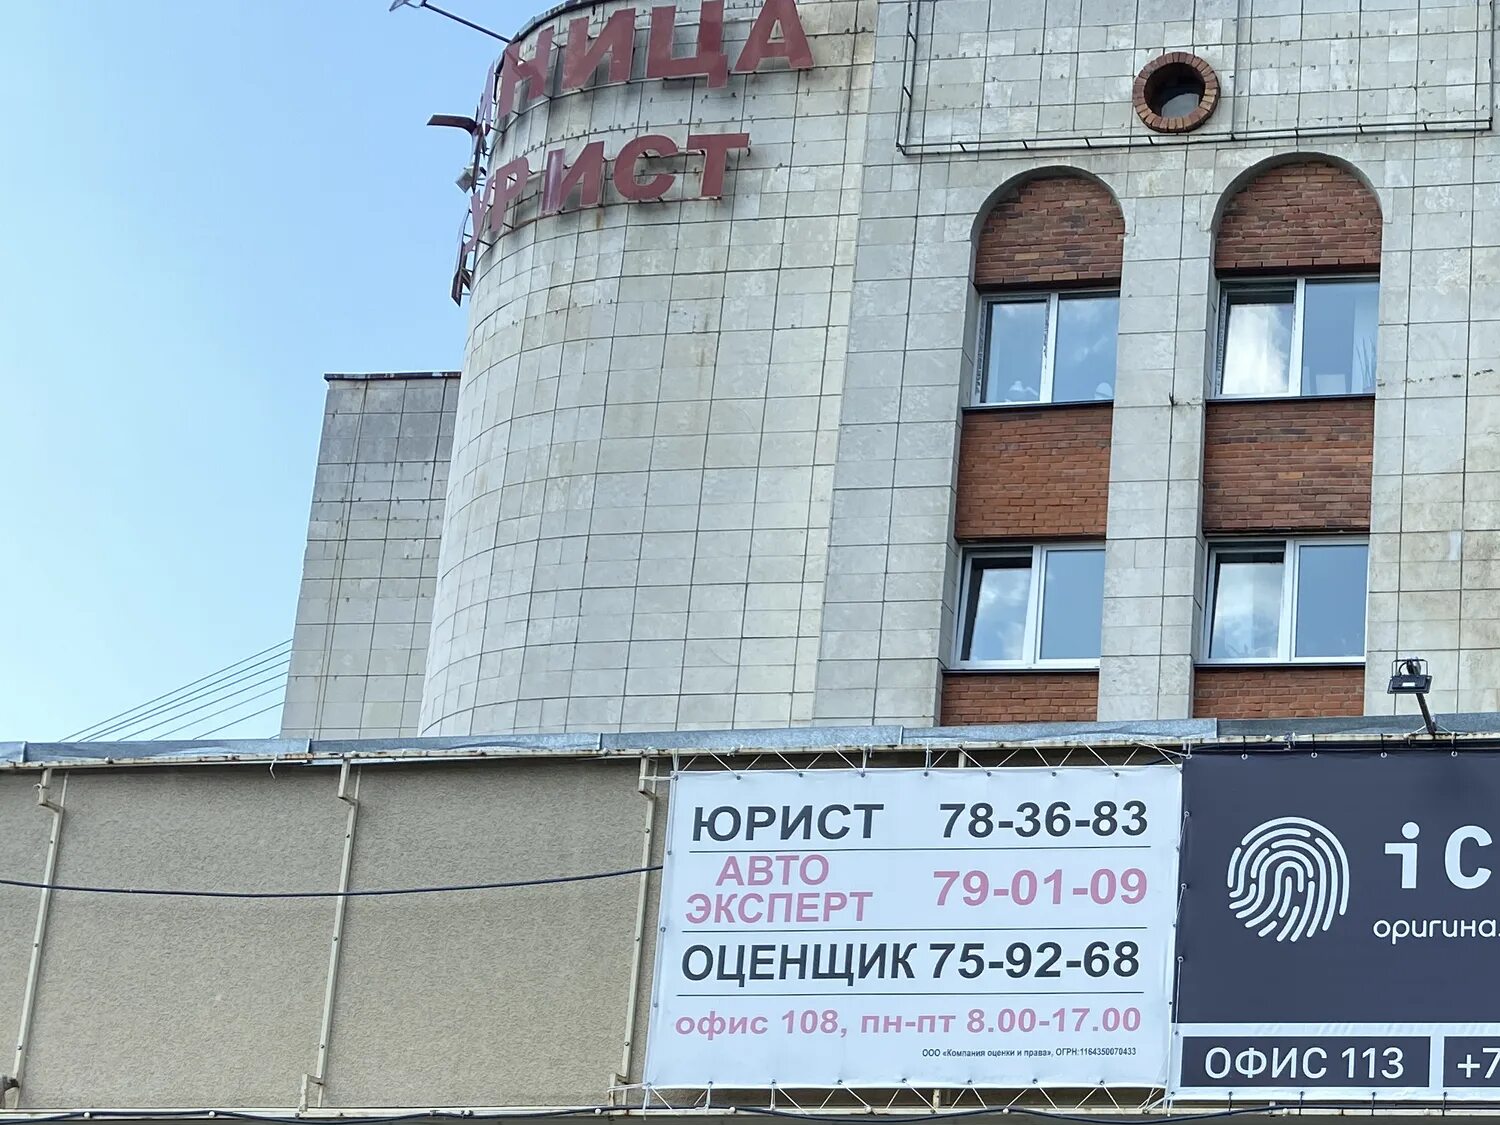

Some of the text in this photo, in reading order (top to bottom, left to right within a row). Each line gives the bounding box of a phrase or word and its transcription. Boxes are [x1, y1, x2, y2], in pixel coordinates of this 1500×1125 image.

[475, 0, 814, 125] НИЦА
[691, 800, 1149, 842] ЮРИСТ 78-36-83
[715, 854, 830, 887] АВТО
[933, 867, 1148, 907] 79-01-09
[685, 891, 873, 924] ЭКСПЕРТ
[681, 941, 1140, 988] ОЦЕНЩИК 75-92-68
[675, 1006, 1141, 1041] офис 108, пн-пт 8.00-17.00
[1204, 1047, 1404, 1080] ОФИС 113
